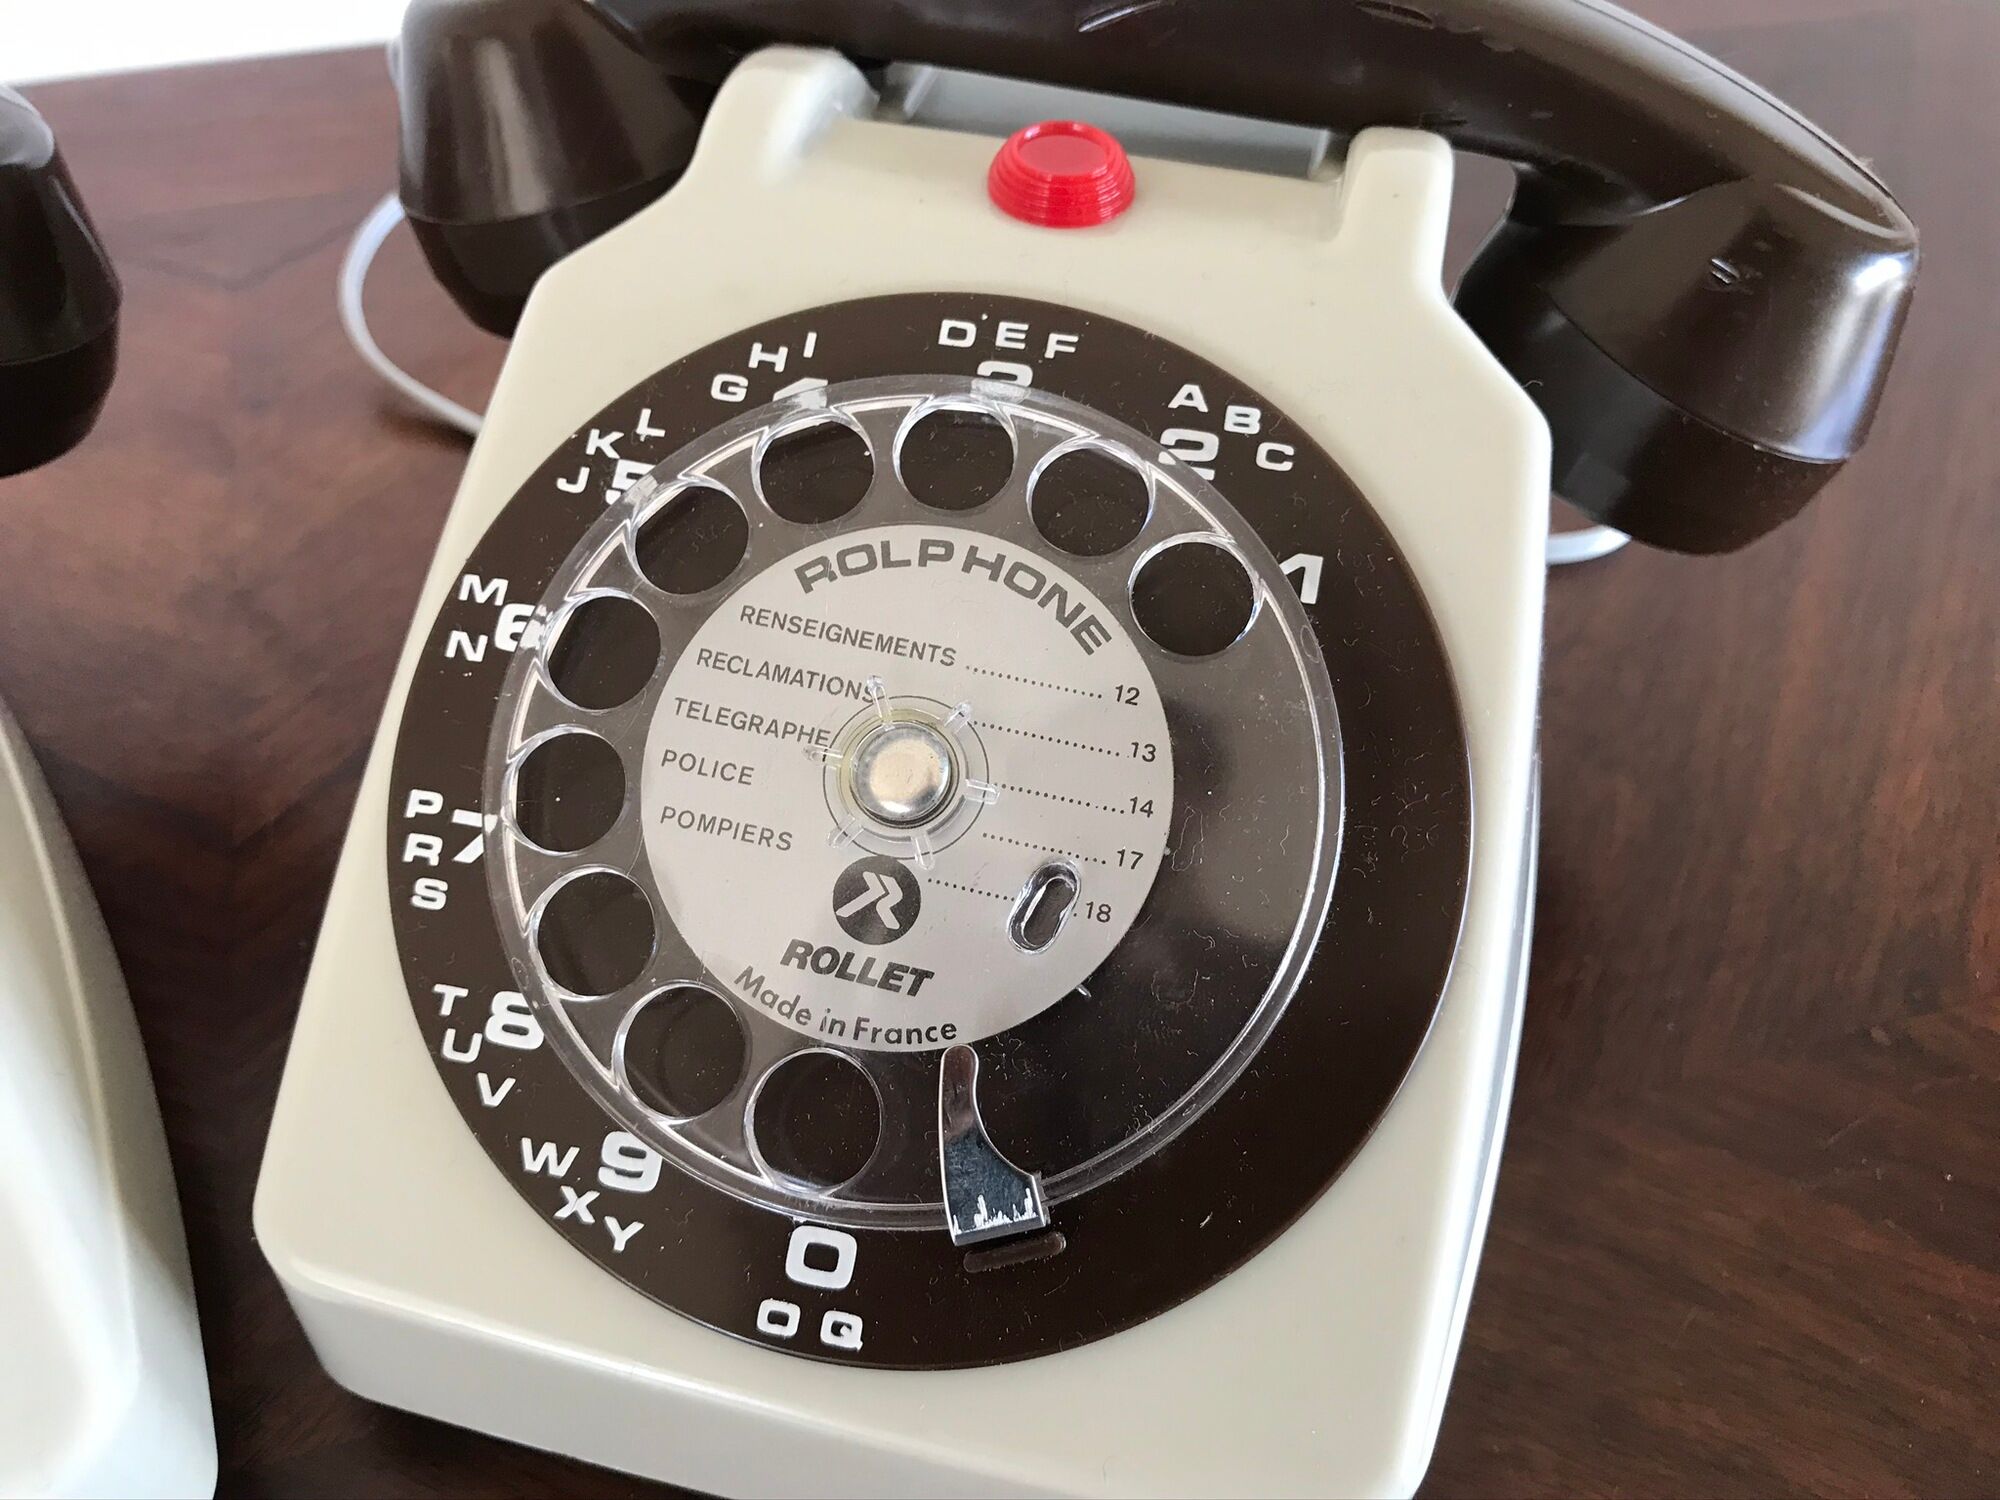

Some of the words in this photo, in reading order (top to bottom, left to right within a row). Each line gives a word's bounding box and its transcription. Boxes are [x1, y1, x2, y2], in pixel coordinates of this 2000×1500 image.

[1158, 427, 1220, 481] 2
[793, 538, 1113, 656] ROLPHONE
[1281, 552, 1324, 605] 1
[494, 603, 550, 652] 6
[739, 604, 957, 668] RENSEIGNEMENTS
[1114, 684, 1141, 706] 12
[696, 648, 875, 705] RECLAMATIONS
[1130, 741, 1158, 763] 13
[673, 697, 832, 748] TELEGRAPHE
[1129, 796, 1155, 819] 14
[451, 809, 497, 863] 7
[661, 749, 755, 785] POLICE
[1116, 848, 1144, 870] 17
[660, 805, 794, 852] POMPIERS
[1085, 902, 1113, 924] 18
[780, 938, 935, 998] ROLLET
[485, 990, 545, 1050] 8
[733, 965, 813, 1027] Made
[820, 1006, 846, 1039] in
[853, 1018, 958, 1046] France
[598, 1130, 663, 1193] 9
[786, 1225, 858, 1290] 0
